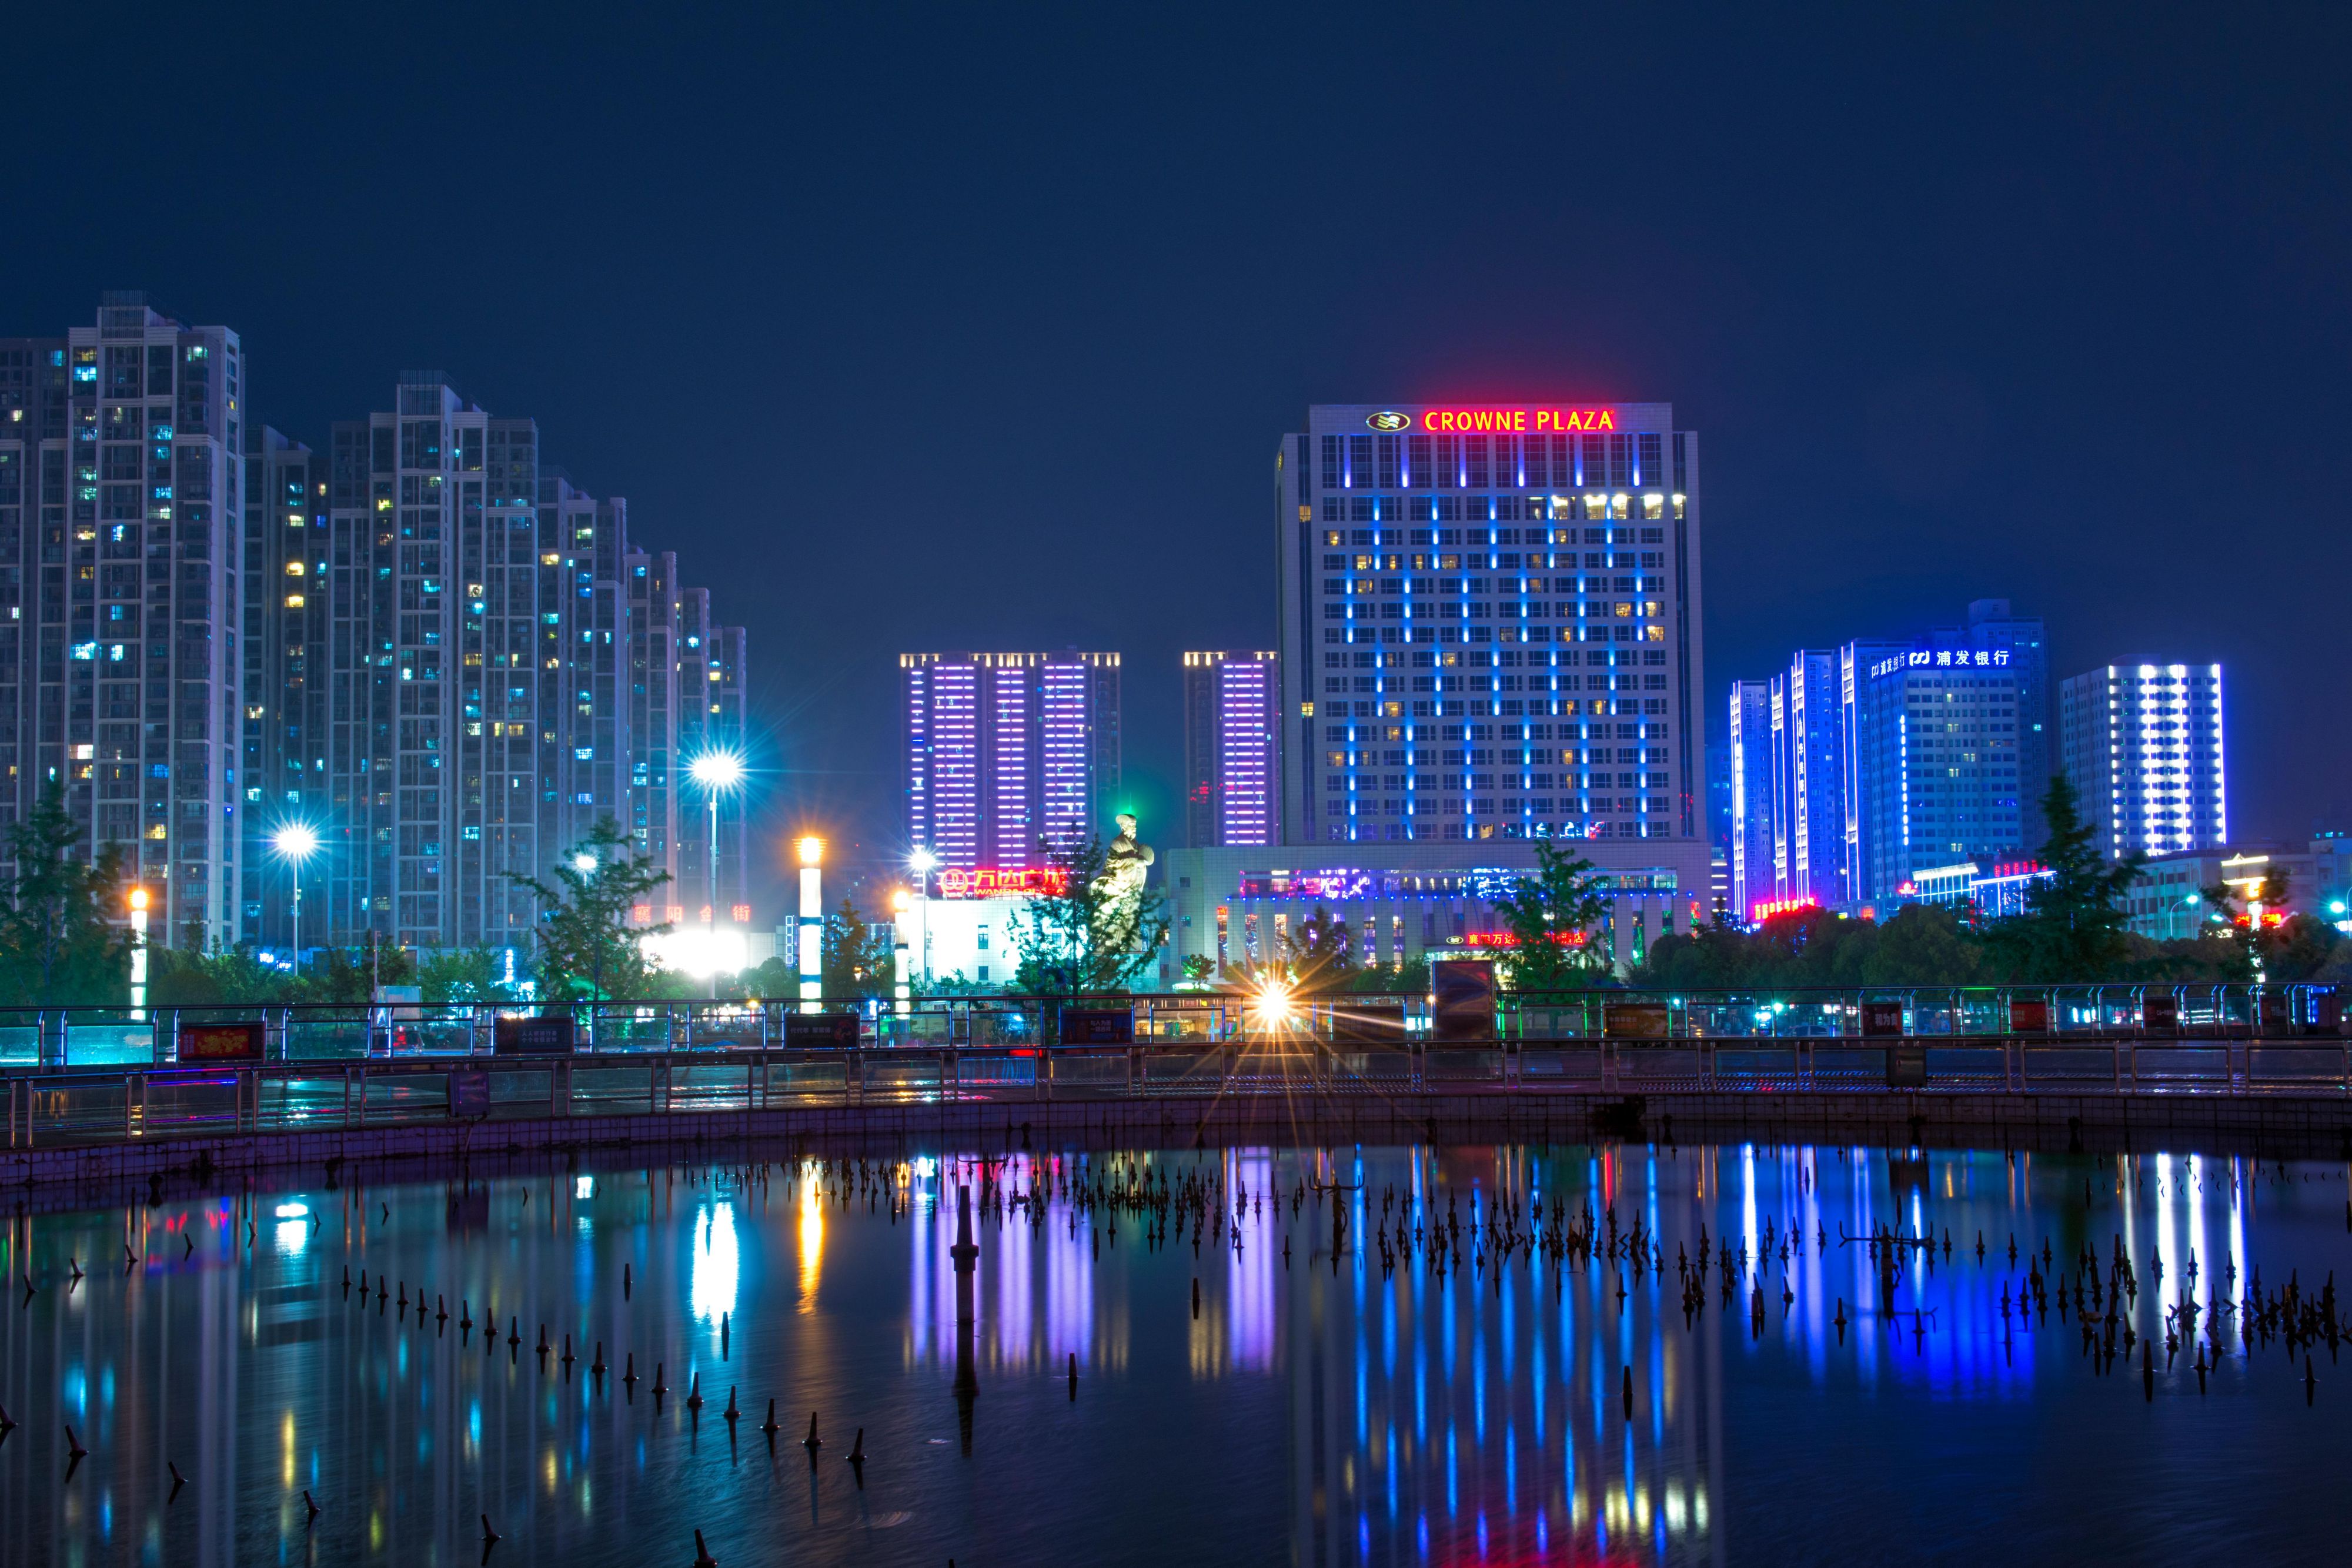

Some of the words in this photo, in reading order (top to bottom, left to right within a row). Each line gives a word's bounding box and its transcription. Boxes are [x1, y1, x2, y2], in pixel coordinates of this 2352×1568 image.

[1424, 411, 1526, 431] CROWNE
[1880, 652, 1905, 676] 浦发银行
[1936, 650, 2009, 666] 浦发银行
[634, 905, 750, 922] 襄阳金街
